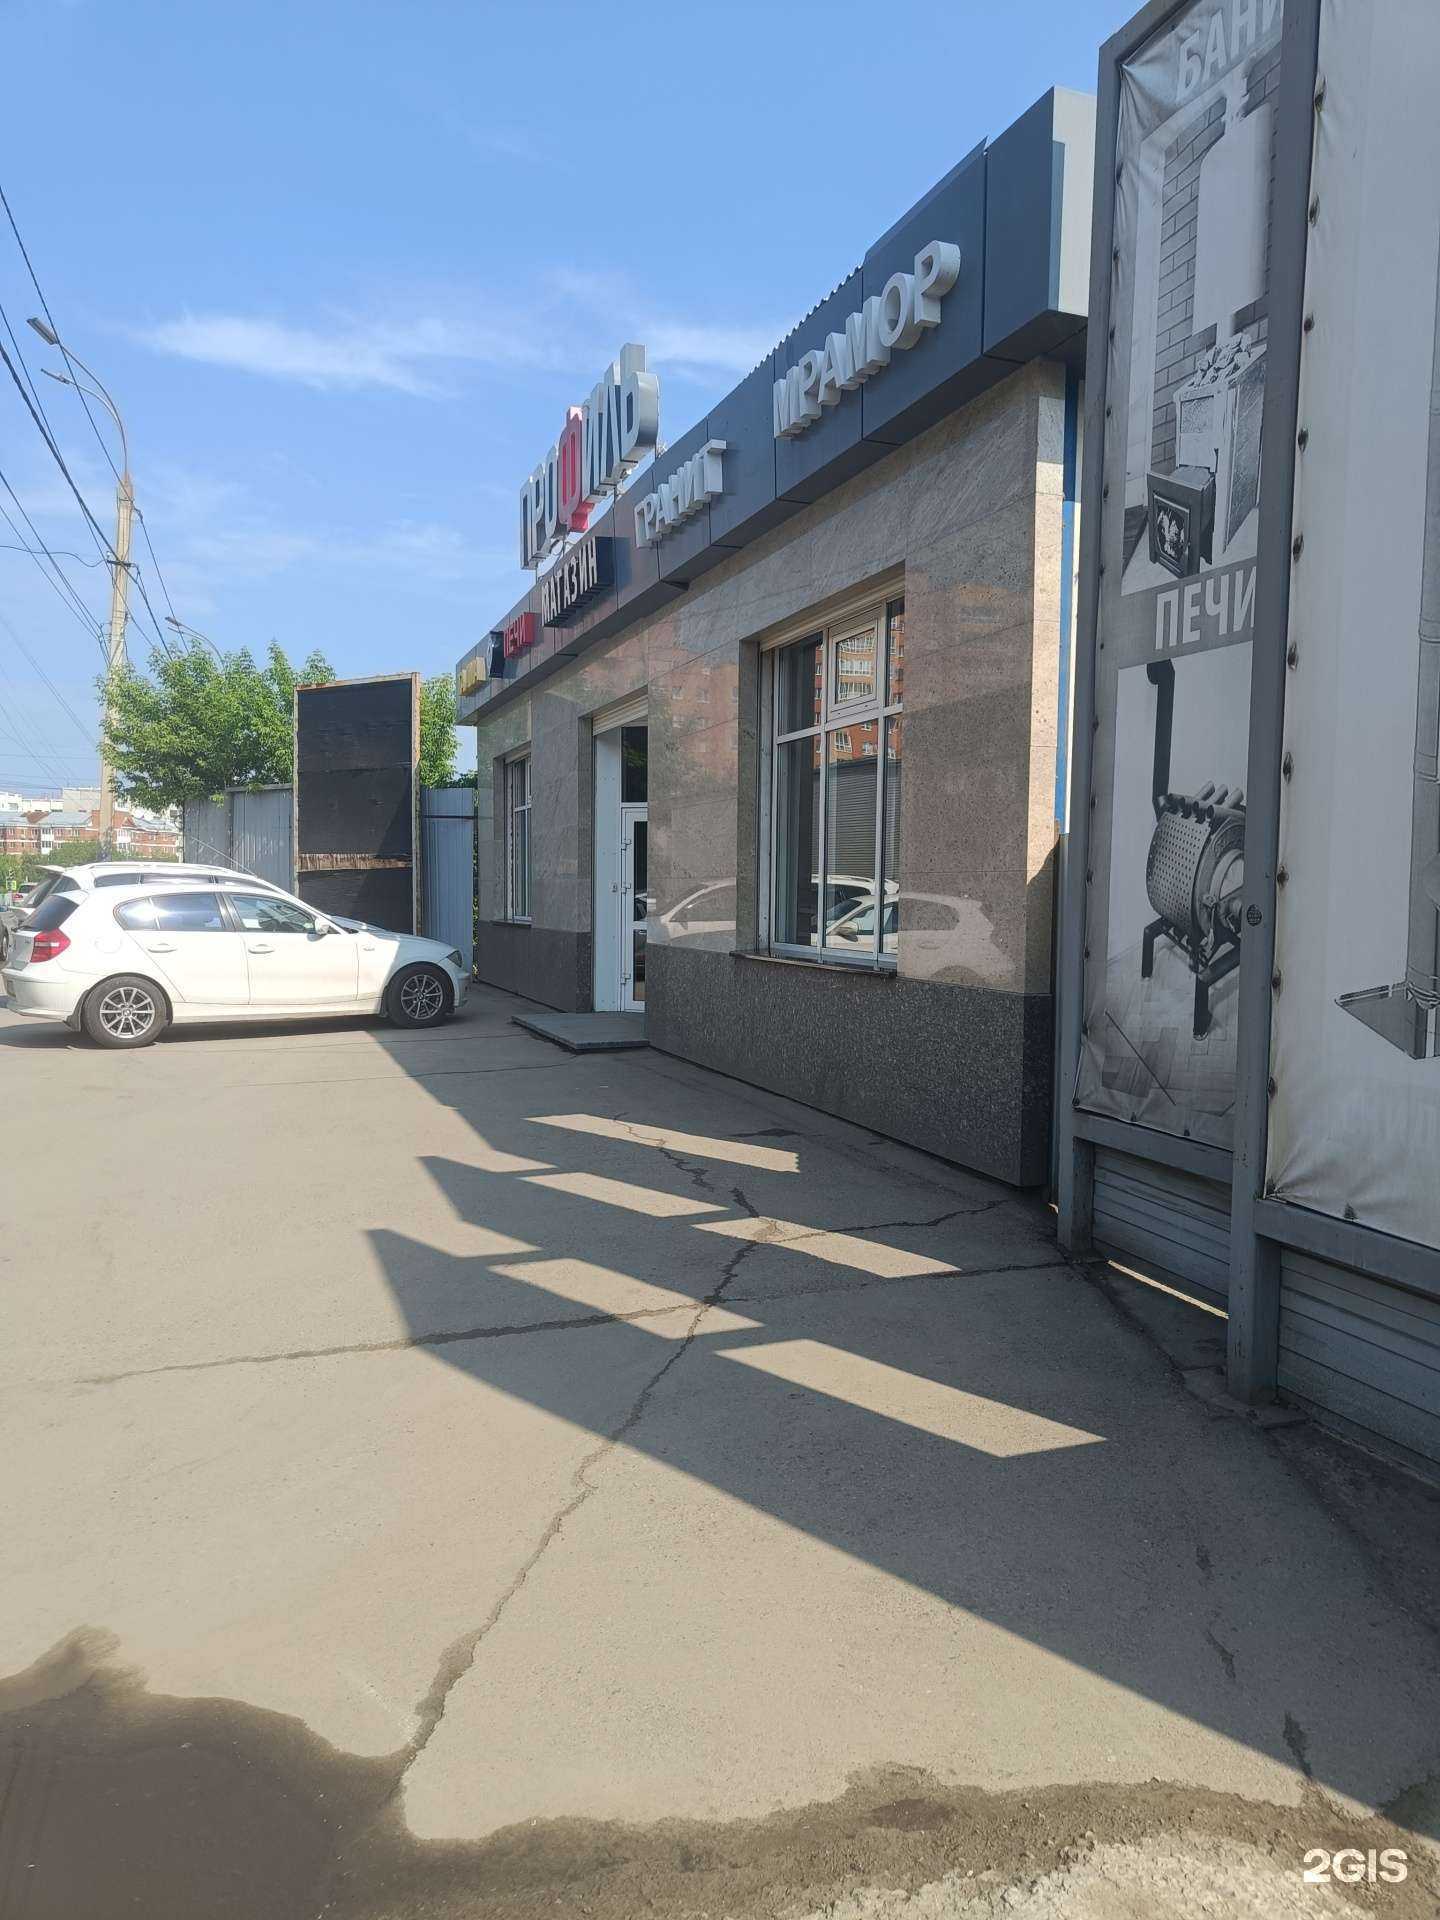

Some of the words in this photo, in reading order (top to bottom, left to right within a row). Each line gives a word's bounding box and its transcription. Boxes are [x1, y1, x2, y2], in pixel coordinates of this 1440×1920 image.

[773, 240, 961, 440] МРАМОР
[519, 343, 659, 570] ПРОФИЛЬ
[634, 439, 727, 548] ГРАНИТ
[541, 536, 598, 627] МАГАЗИН
[1155, 566, 1257, 651] ПЕЧИ
